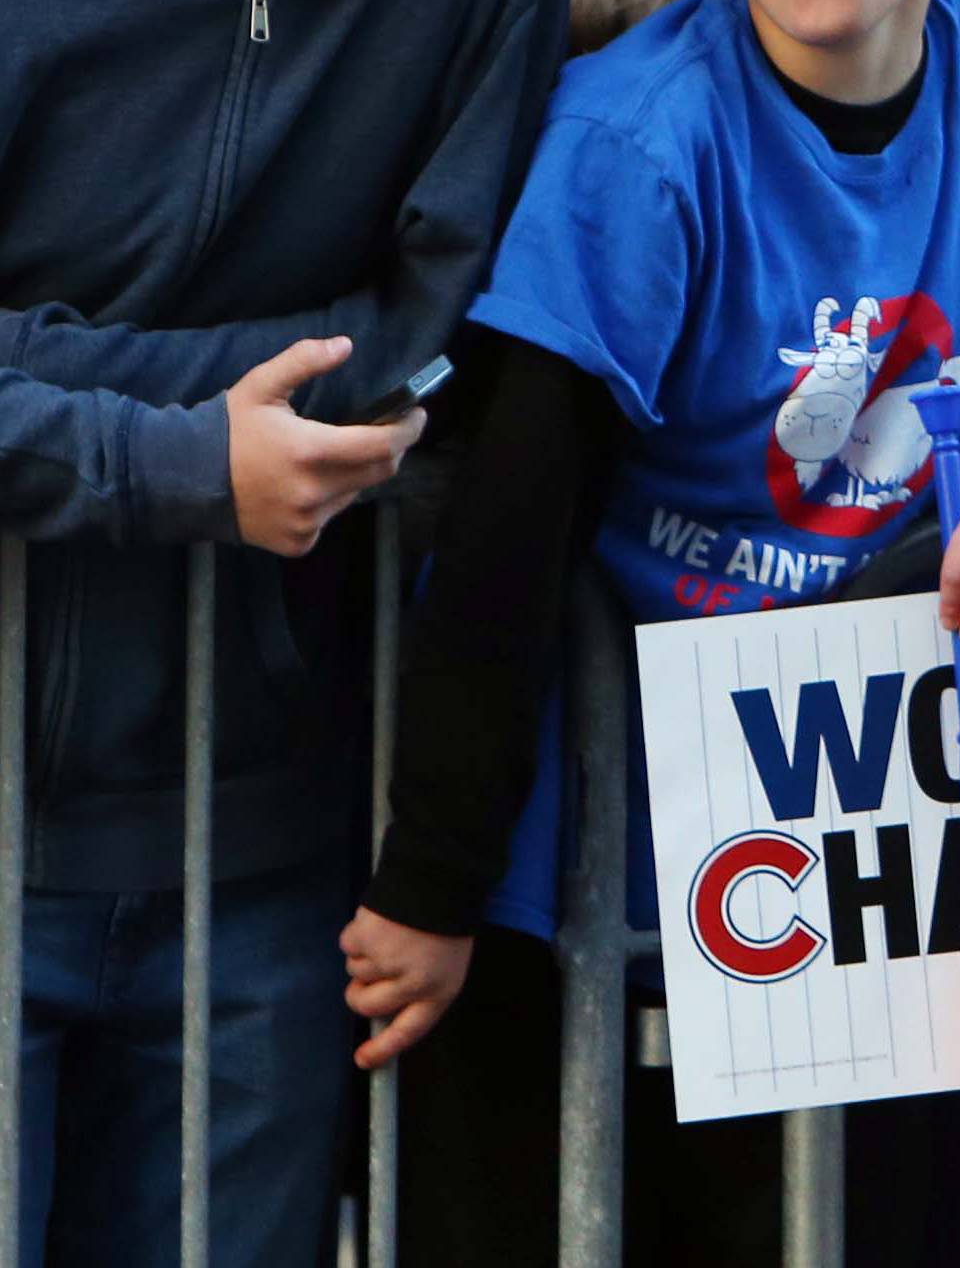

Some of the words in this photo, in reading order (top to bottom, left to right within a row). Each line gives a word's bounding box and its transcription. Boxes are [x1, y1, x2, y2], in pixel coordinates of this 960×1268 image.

[649, 507, 719, 570] WE
[725, 538, 847, 594] AIN'T
[673, 573, 740, 615] OF
